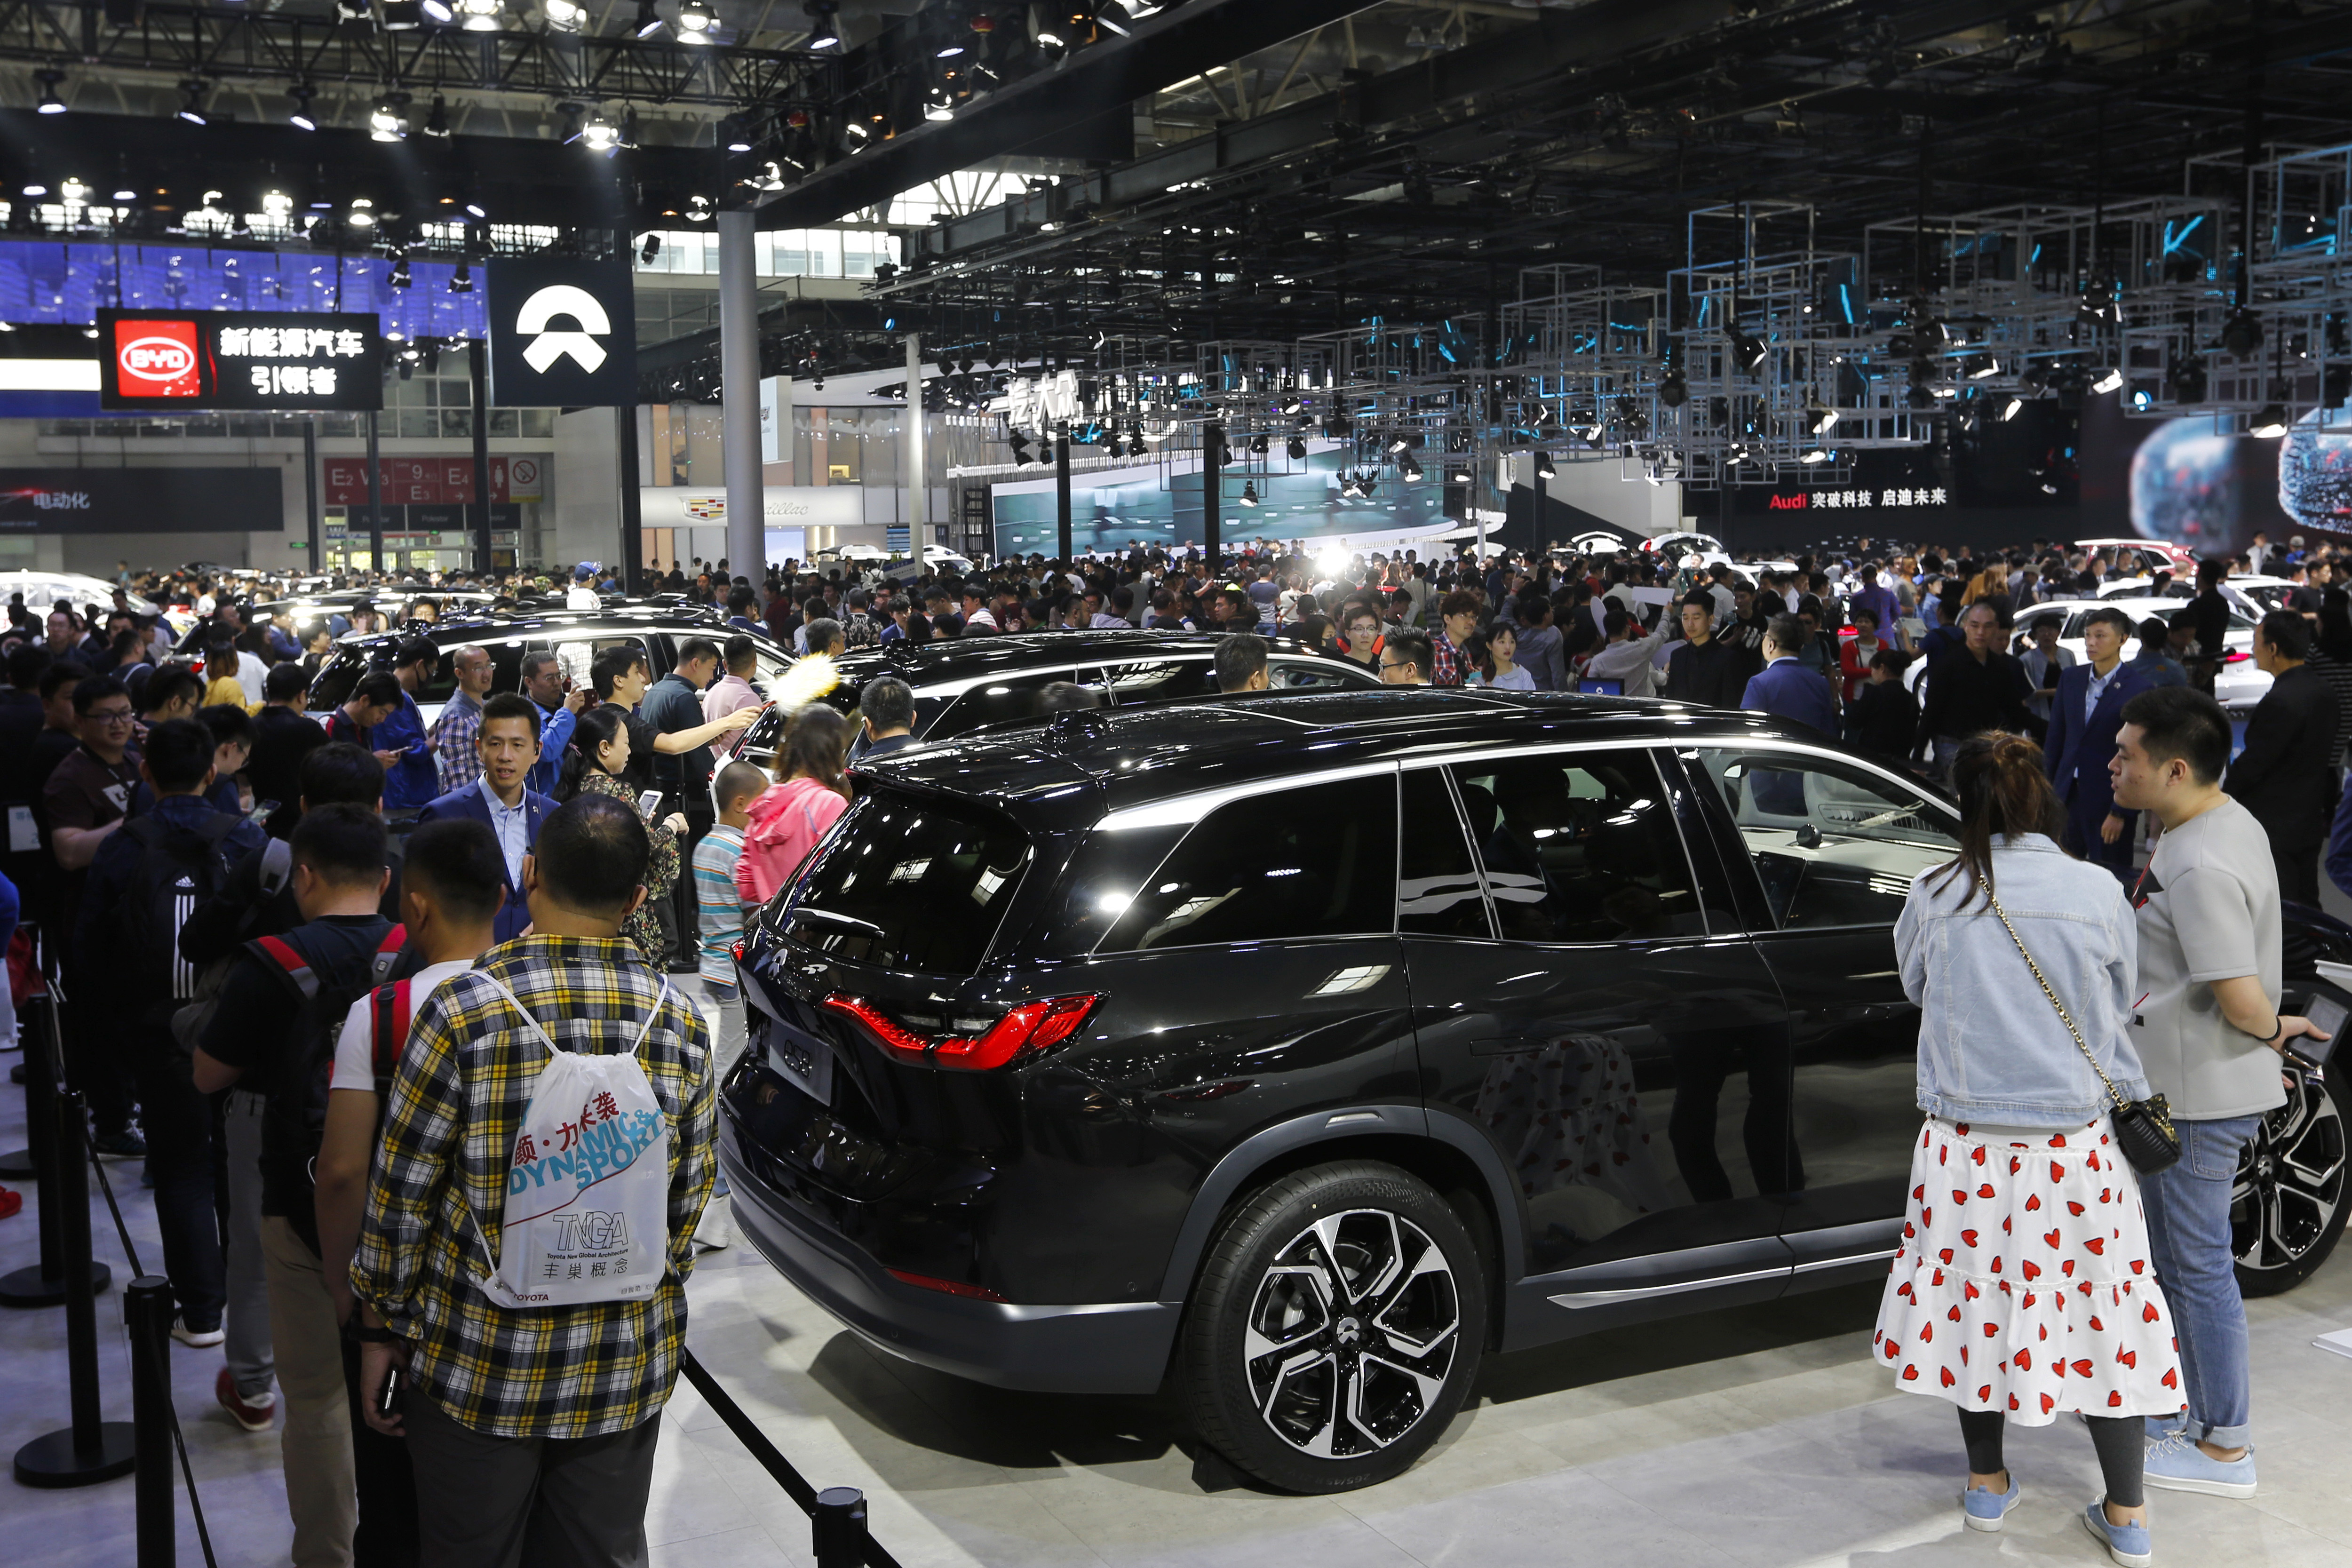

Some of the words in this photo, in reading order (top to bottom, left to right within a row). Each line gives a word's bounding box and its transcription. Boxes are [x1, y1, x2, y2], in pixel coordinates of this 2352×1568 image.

[220, 327, 365, 358] 新能源汽车
[130, 349, 185, 368] BYD
[251, 366, 337, 395] 引领者
[332, 469, 353, 486] E2
[412, 464, 422, 479] 9
[448, 468, 469, 485] E4
[33, 492, 90, 509] 电动化
[411, 486, 429, 500] E3
[1770, 493, 1806, 509] Audi
[1812, 490, 1872, 508] 突破科技
[1882, 487, 1947, 506] 启迪未来
[764, 502, 808, 515] dillac
[509, 1111, 637, 1196] DYNAMIC
[576, 1108, 664, 1190] SPORT
[553, 1210, 628, 1251] TNGA
[598, 1248, 628, 1258] Architecture
[543, 1258, 628, 1280] 丰巢概念
[1326, 1472, 1371, 1485] 265/45
